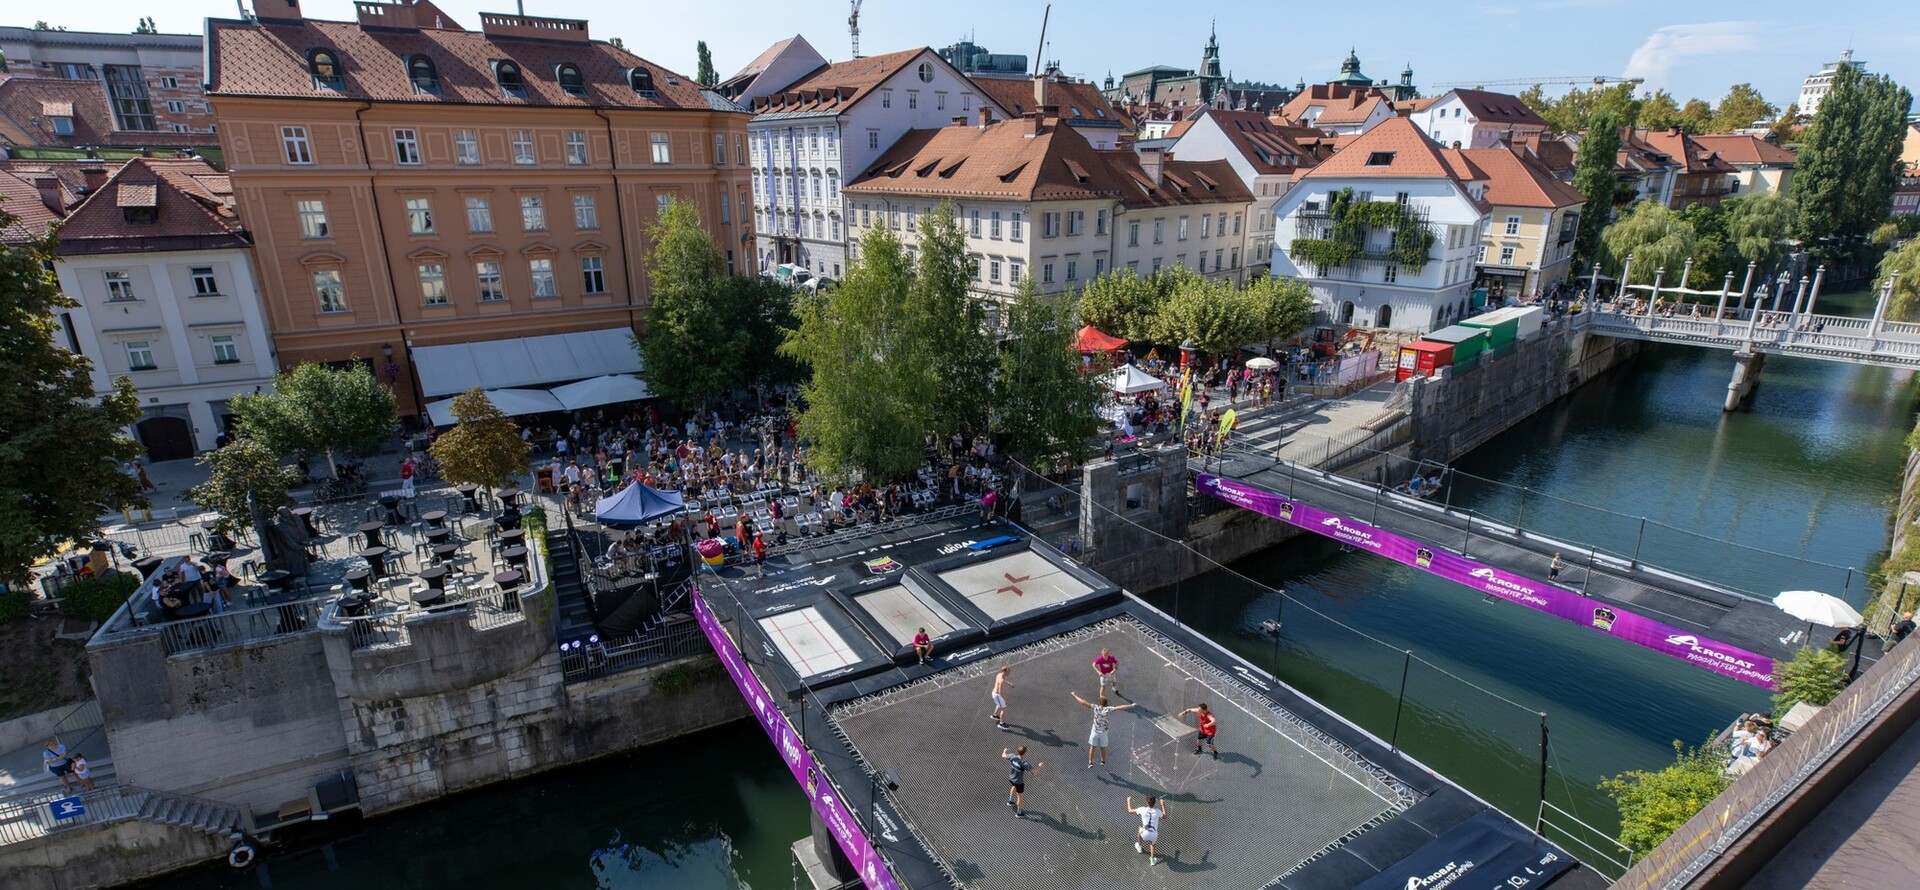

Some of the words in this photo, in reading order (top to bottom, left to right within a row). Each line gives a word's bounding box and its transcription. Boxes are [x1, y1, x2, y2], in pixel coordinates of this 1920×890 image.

[1321, 517, 1373, 540] AKROBAT
[1468, 568, 1535, 596] AKROBAT
[1664, 634, 1756, 670] AKROBAT
